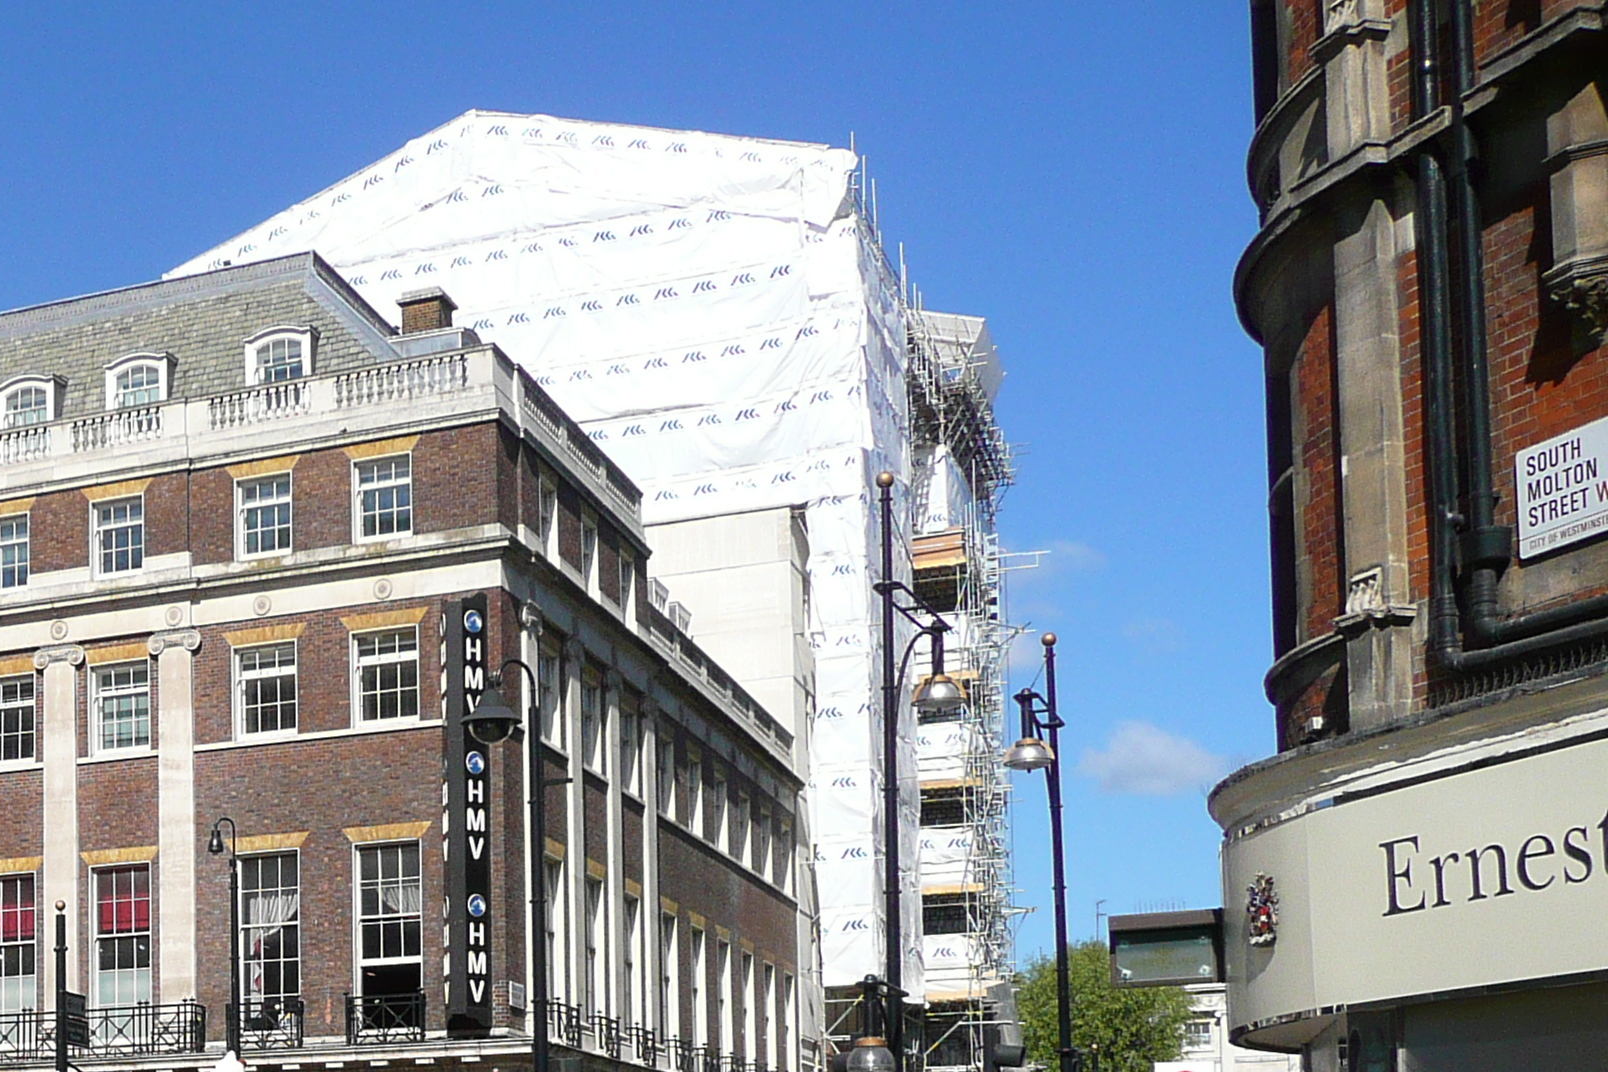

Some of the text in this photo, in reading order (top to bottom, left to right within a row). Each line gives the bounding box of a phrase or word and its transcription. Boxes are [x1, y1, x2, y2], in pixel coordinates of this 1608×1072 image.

[1526, 437, 1581, 477] SOUTH
[1527, 457, 1597, 504] MOLTON
[1528, 487, 1589, 528] STREET
[1529, 536, 1546, 551] CITY
[1547, 533, 1558, 545] OF
[466, 778, 486, 860] HMV
[467, 921, 487, 1004] HMV
